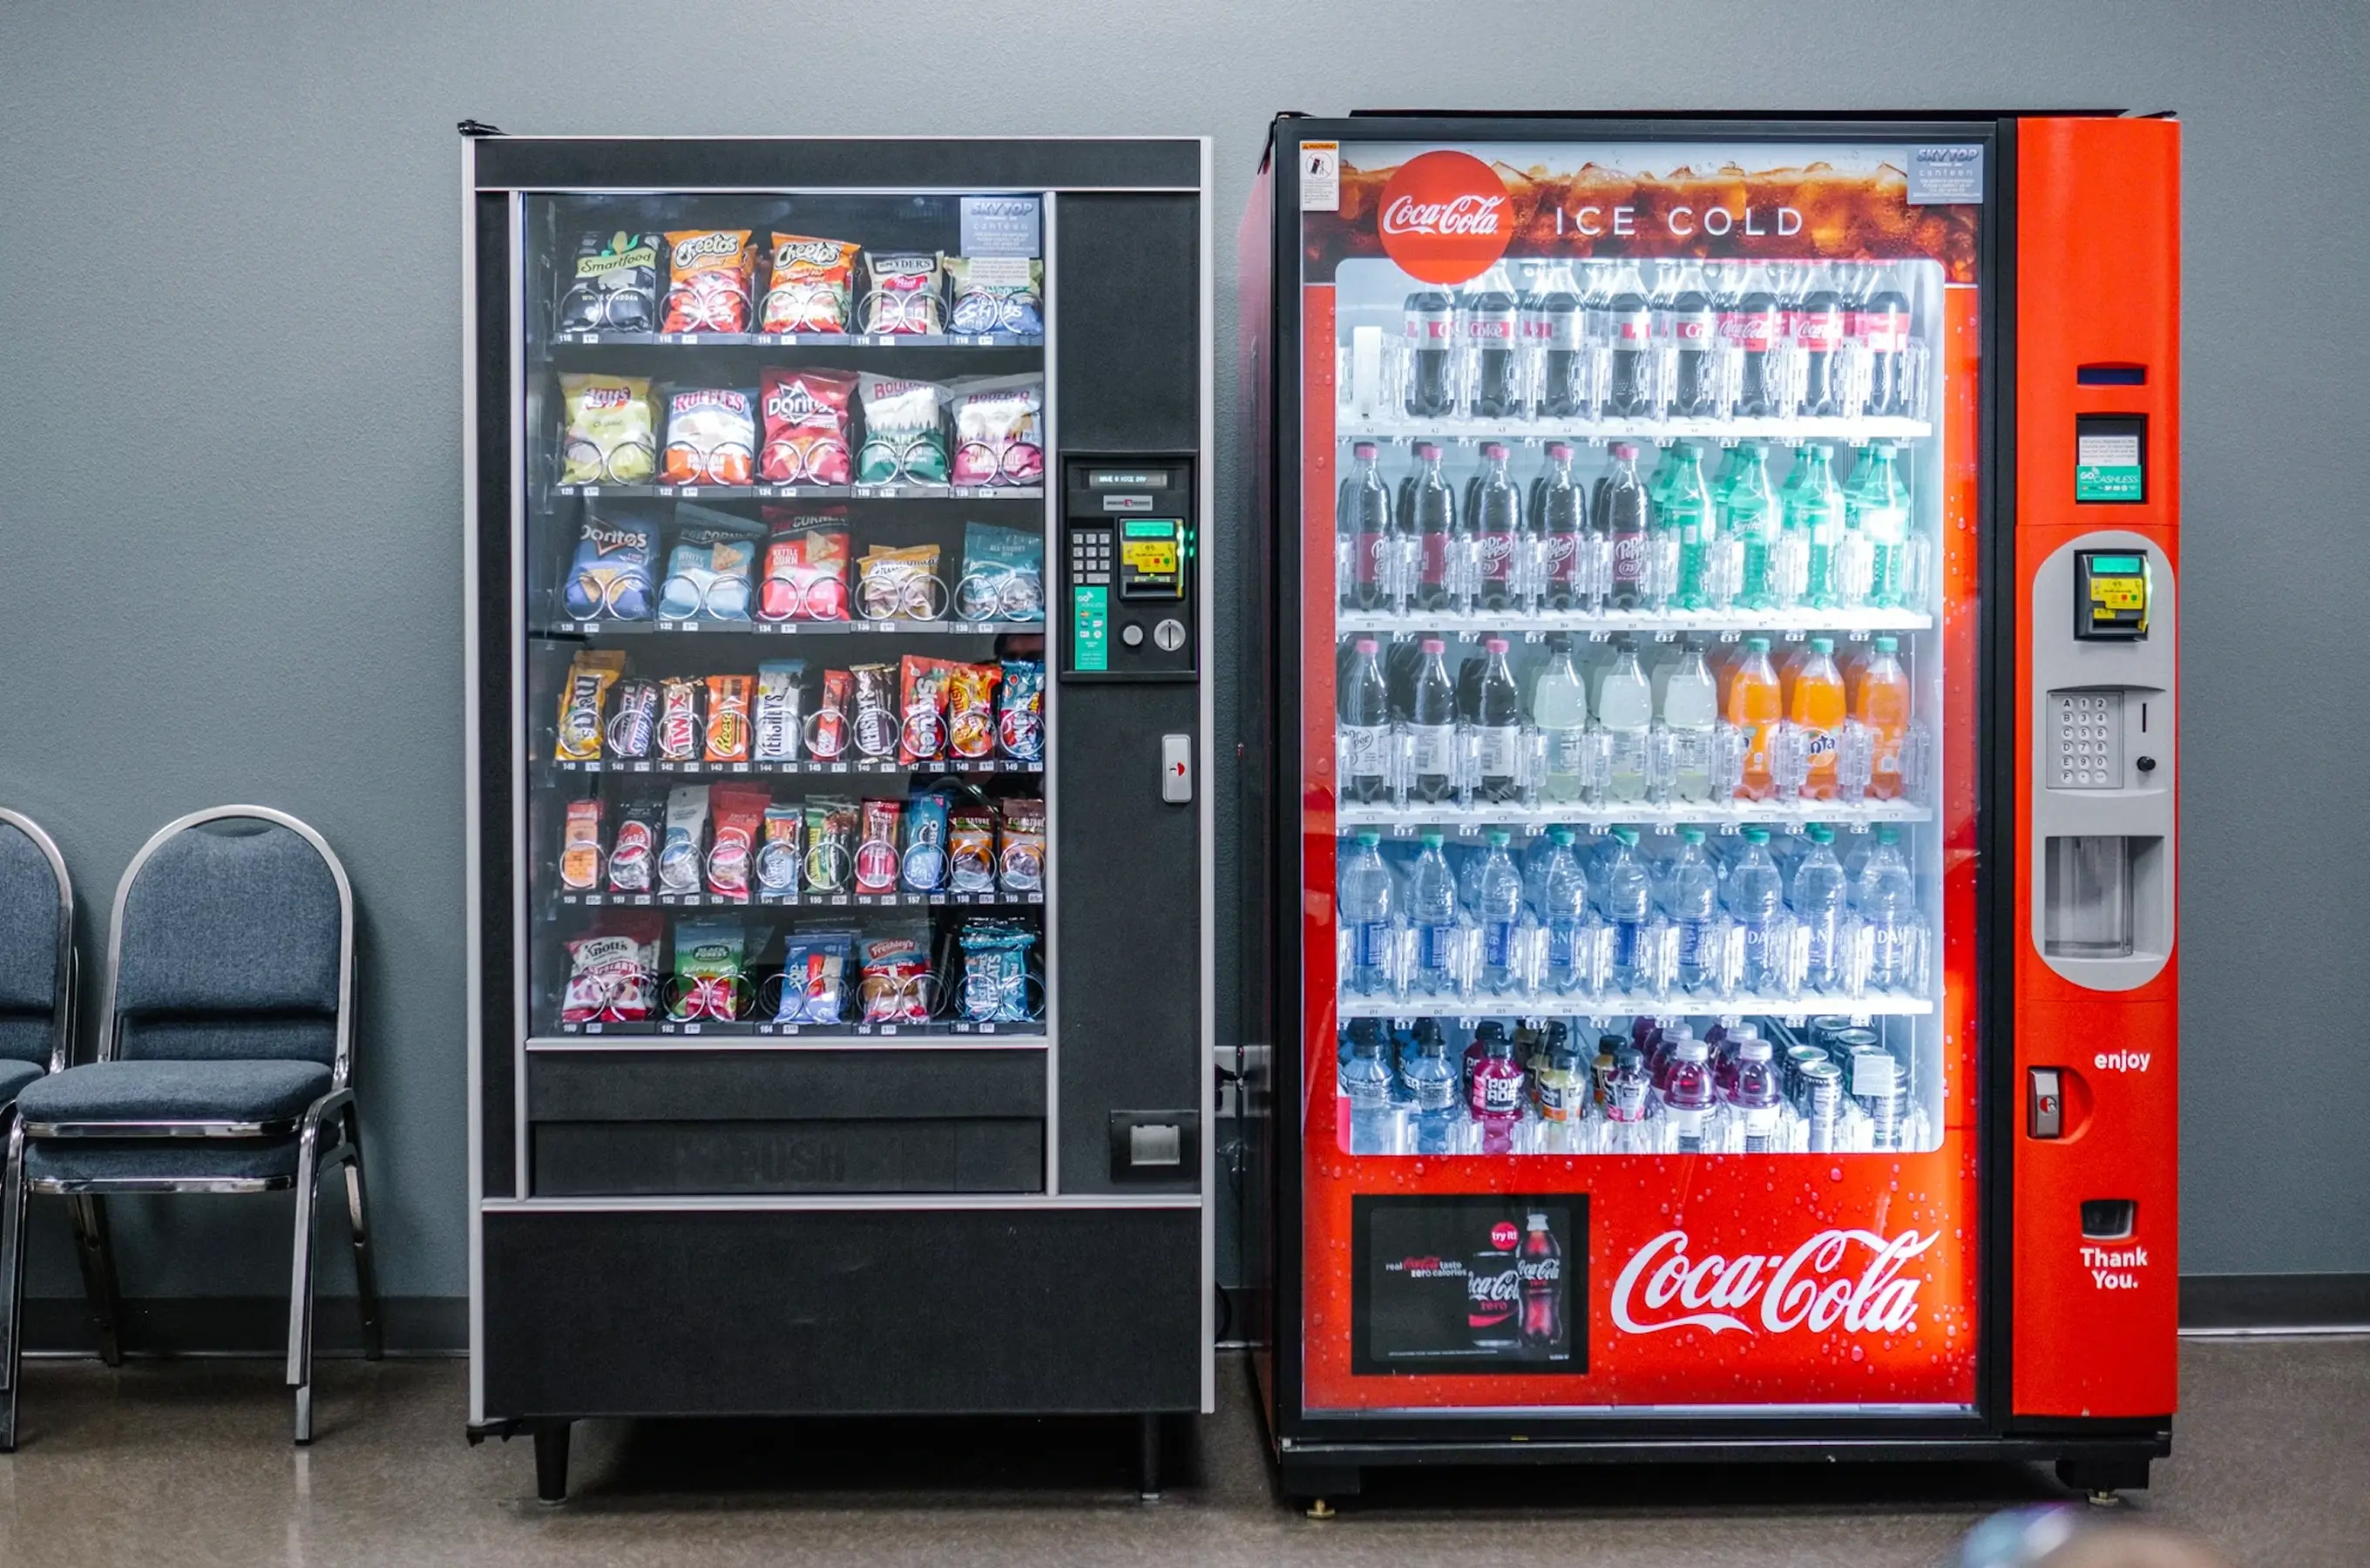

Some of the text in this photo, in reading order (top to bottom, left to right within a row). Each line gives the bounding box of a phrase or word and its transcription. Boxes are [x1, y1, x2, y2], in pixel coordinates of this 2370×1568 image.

[1383, 195, 1506, 234] Coca-Cola
[1556, 206, 1803, 236] ICE COLD
[677, 234, 738, 268] Cheetos
[776, 242, 840, 267] Cheetos
[581, 253, 652, 274] Smartfood
[1471, 322, 1503, 338] Coke
[674, 390, 745, 412] RUFFLES
[773, 556, 799, 565] CORN
[2094, 1049, 2150, 1072] enjoy
[1492, 1232, 1507, 1242] try
[2080, 1247, 2148, 1267] Thank
[1432, 1268, 1466, 1277] calories
[1611, 1229, 1941, 1335] Coca-Cola
[2091, 1269, 2138, 1289] You.
